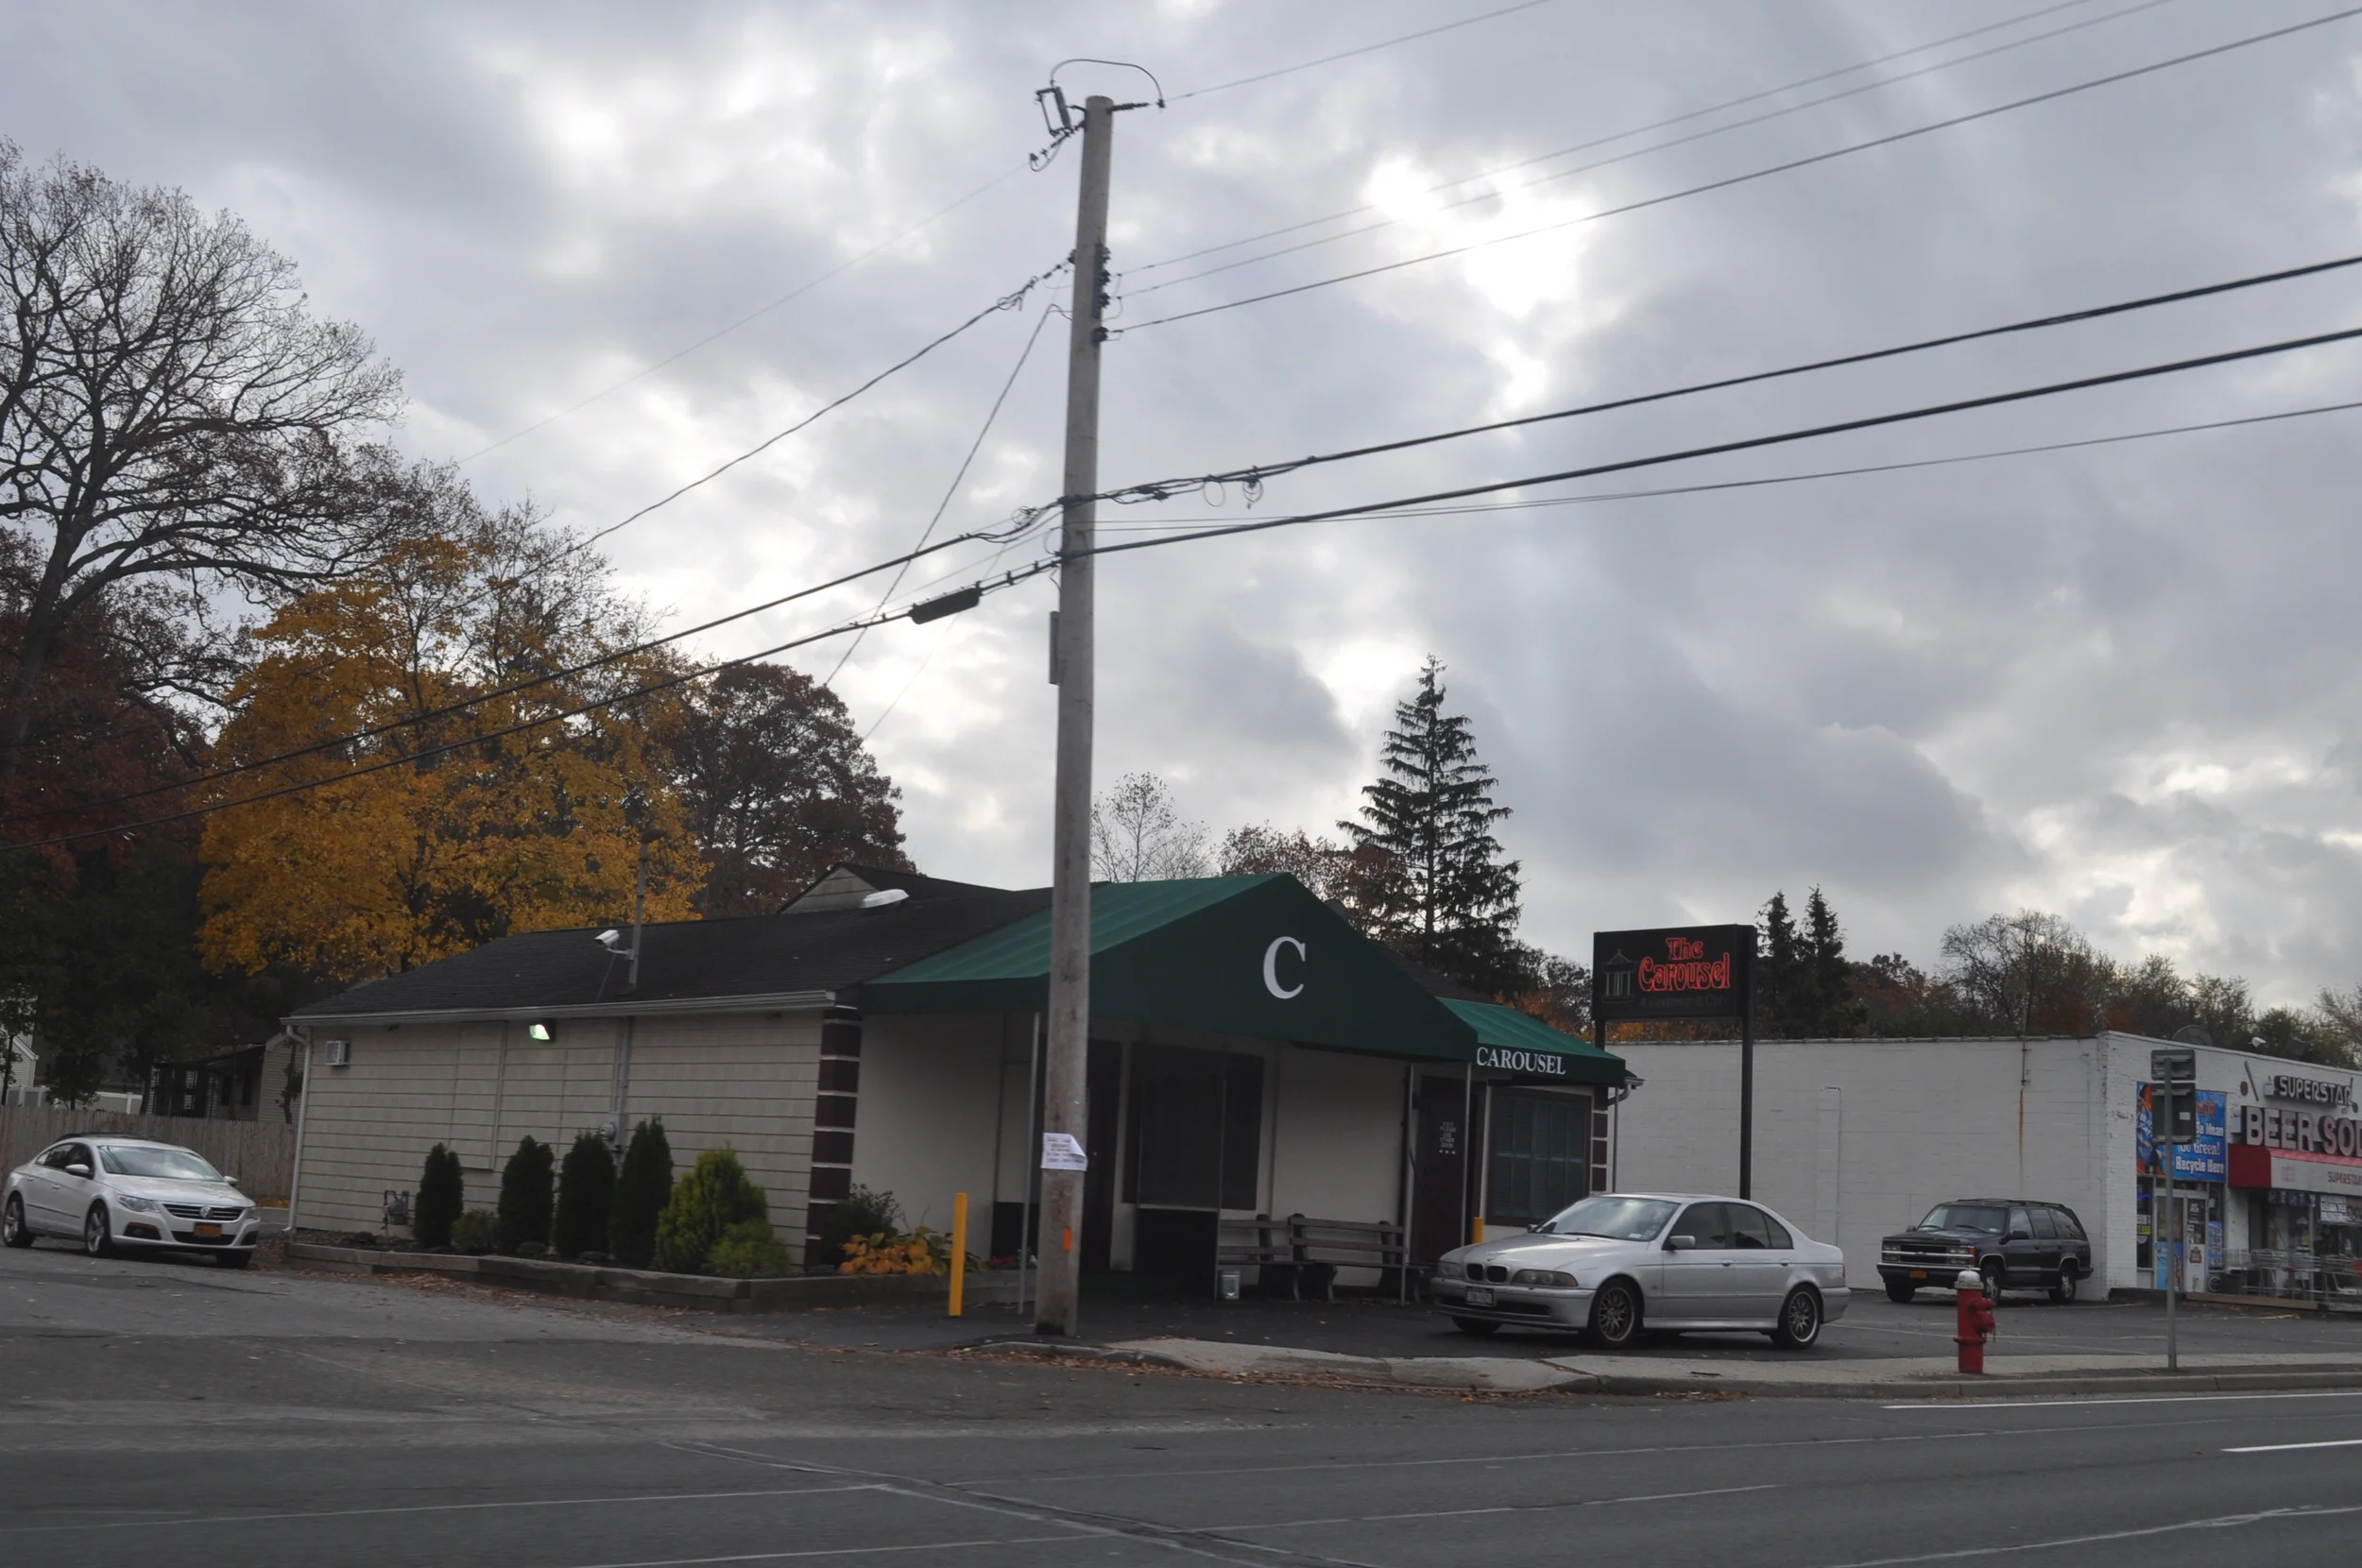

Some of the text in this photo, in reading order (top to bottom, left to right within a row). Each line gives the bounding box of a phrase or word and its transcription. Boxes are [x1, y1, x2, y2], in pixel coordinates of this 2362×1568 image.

[1666, 937, 1704, 961] The
[1263, 936, 1306, 999] C
[1638, 952, 1731, 992] Carousel
[1476, 1047, 1566, 1076] CAROUSEL
[2279, 1076, 2353, 1106] SUPERSTAR
[2205, 1122, 2224, 1137] Mean
[2246, 1106, 2315, 1152] BEER
[2175, 1155, 2225, 1174] Recycle Here
